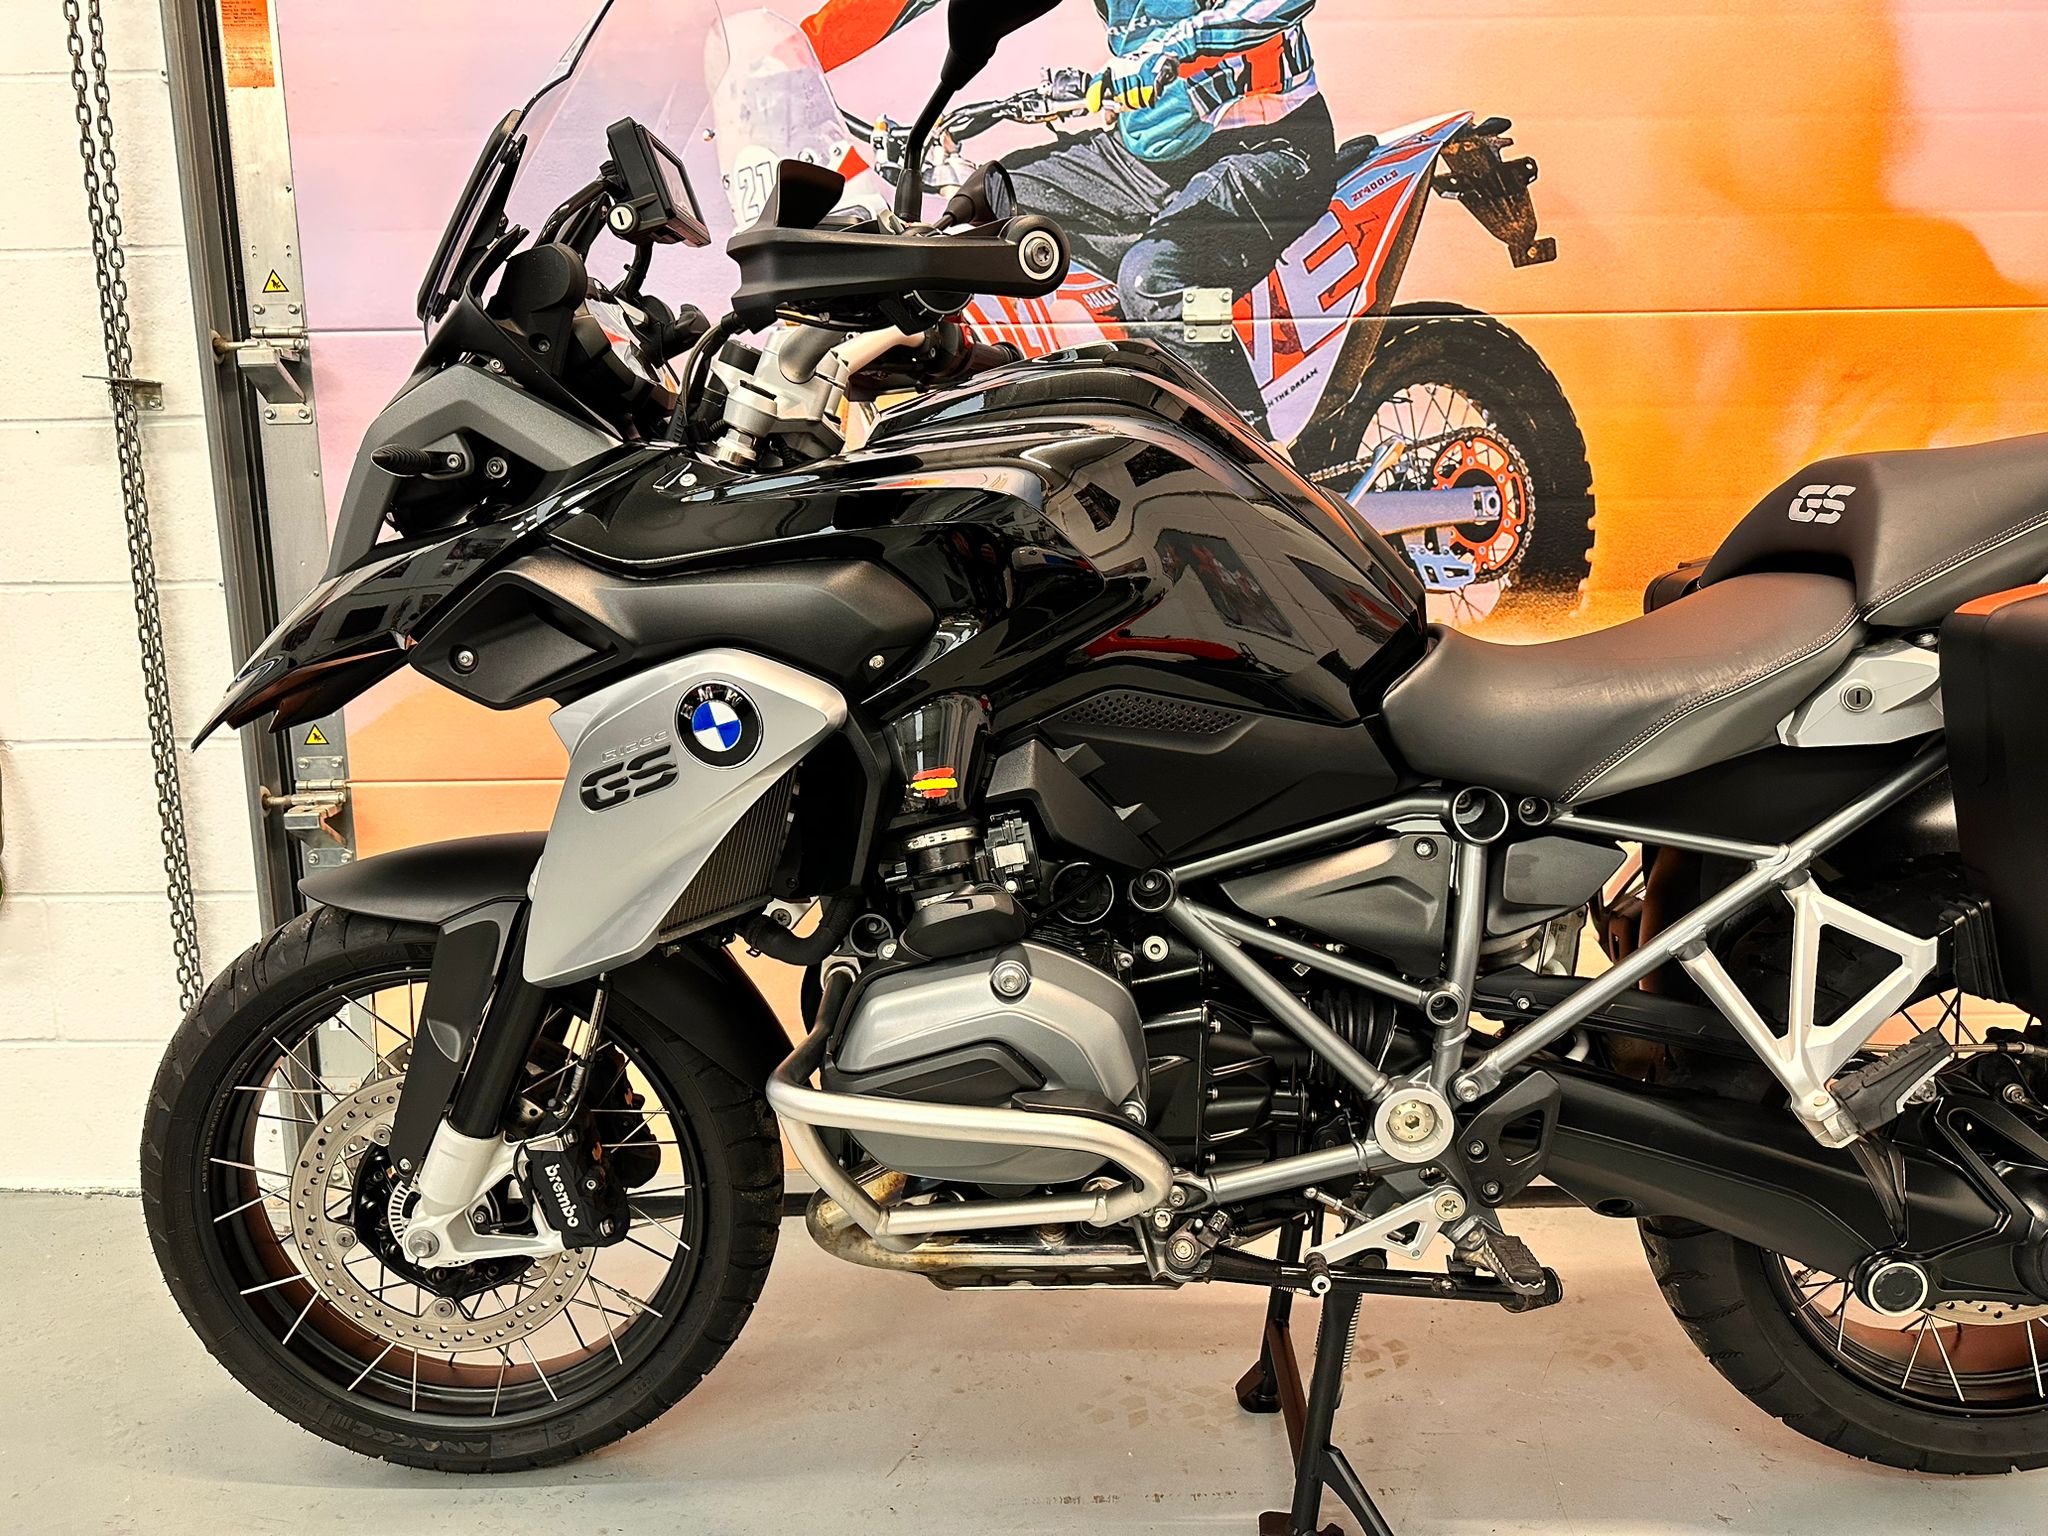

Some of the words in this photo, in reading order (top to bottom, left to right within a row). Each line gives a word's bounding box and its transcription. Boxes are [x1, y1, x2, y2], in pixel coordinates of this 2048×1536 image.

[1081, 286, 1120, 309] RALLY
[1275, 389, 1290, 403] THE
[1290, 368, 1318, 391] DREAM
[1789, 484, 1857, 524] GS
[680, 685, 743, 720] BMW
[581, 744, 679, 813] GS
[544, 1163, 579, 1227] brembo
